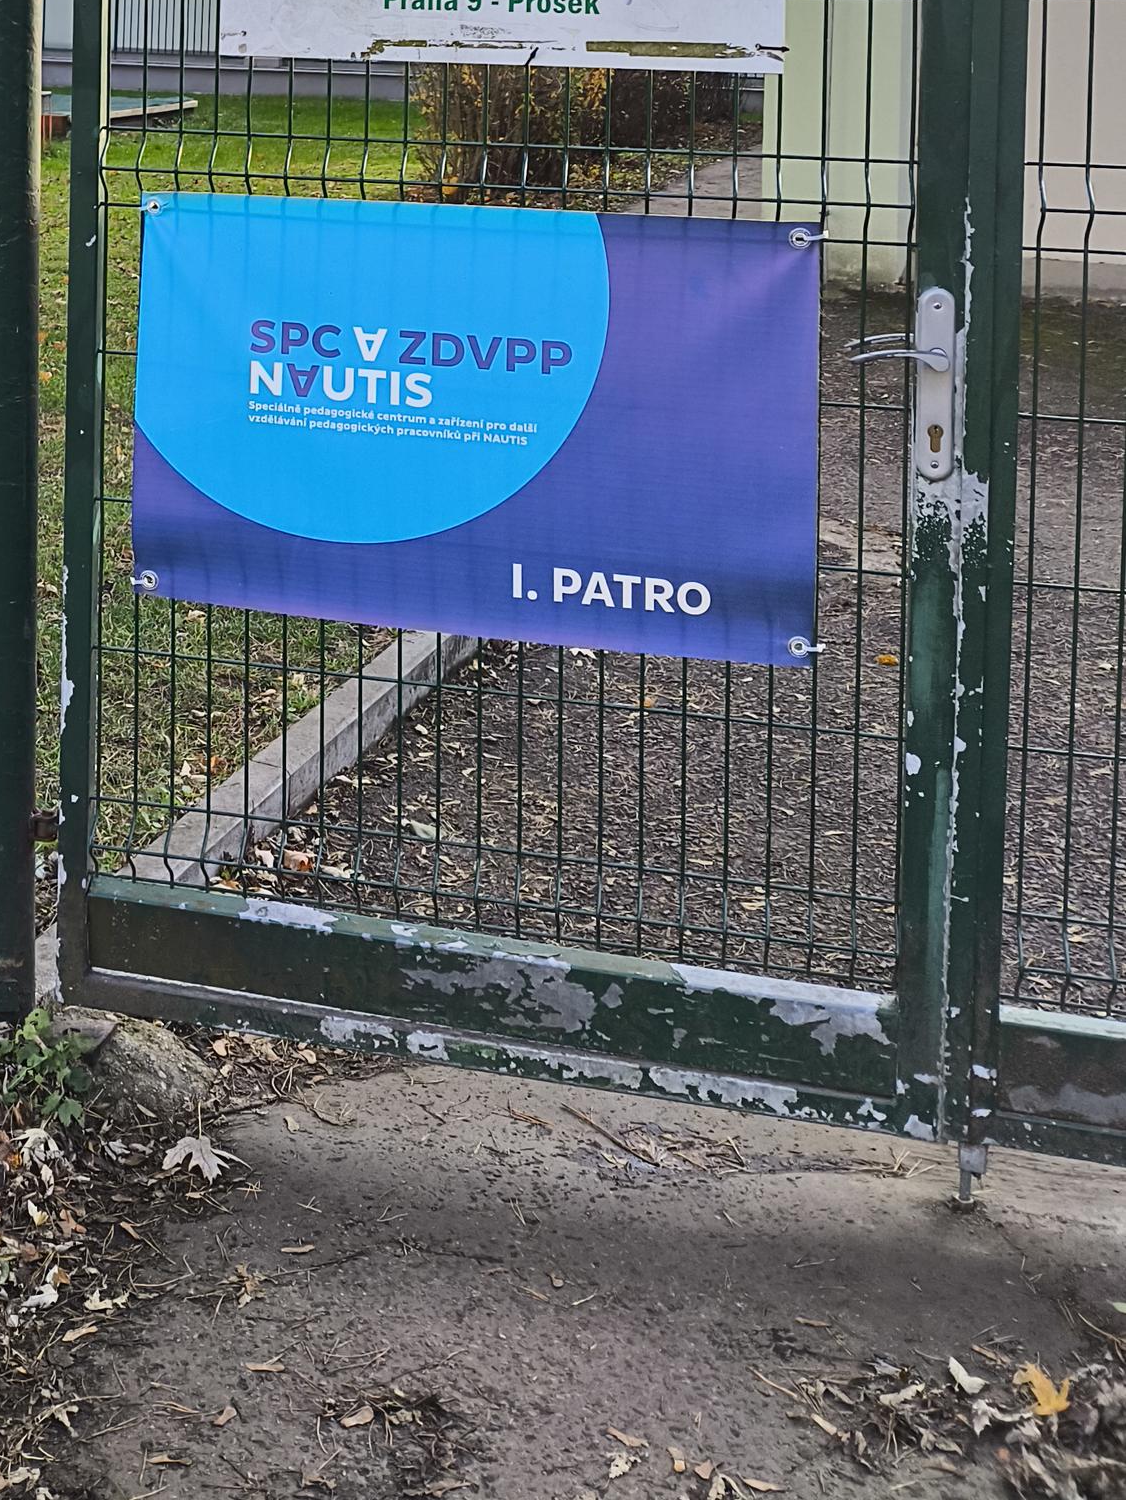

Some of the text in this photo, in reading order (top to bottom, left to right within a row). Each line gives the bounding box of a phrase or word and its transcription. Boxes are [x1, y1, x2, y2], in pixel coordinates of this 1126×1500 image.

[250, 320, 341, 358] SPC
[398, 330, 573, 375] ZDVPP
[249, 360, 433, 408] NAUTIS
[248, 413, 528, 446] vzdělávání pedagogických pracovníků při NAUTIS
[303, 404, 374, 419] pedagogické
[376, 411, 426, 424] centrum
[428, 416, 436, 425] a
[438, 416, 484, 429] zařízení
[486, 421, 506, 433] pro
[509, 422, 538, 433] další
[512, 563, 711, 616] I. PATRO
